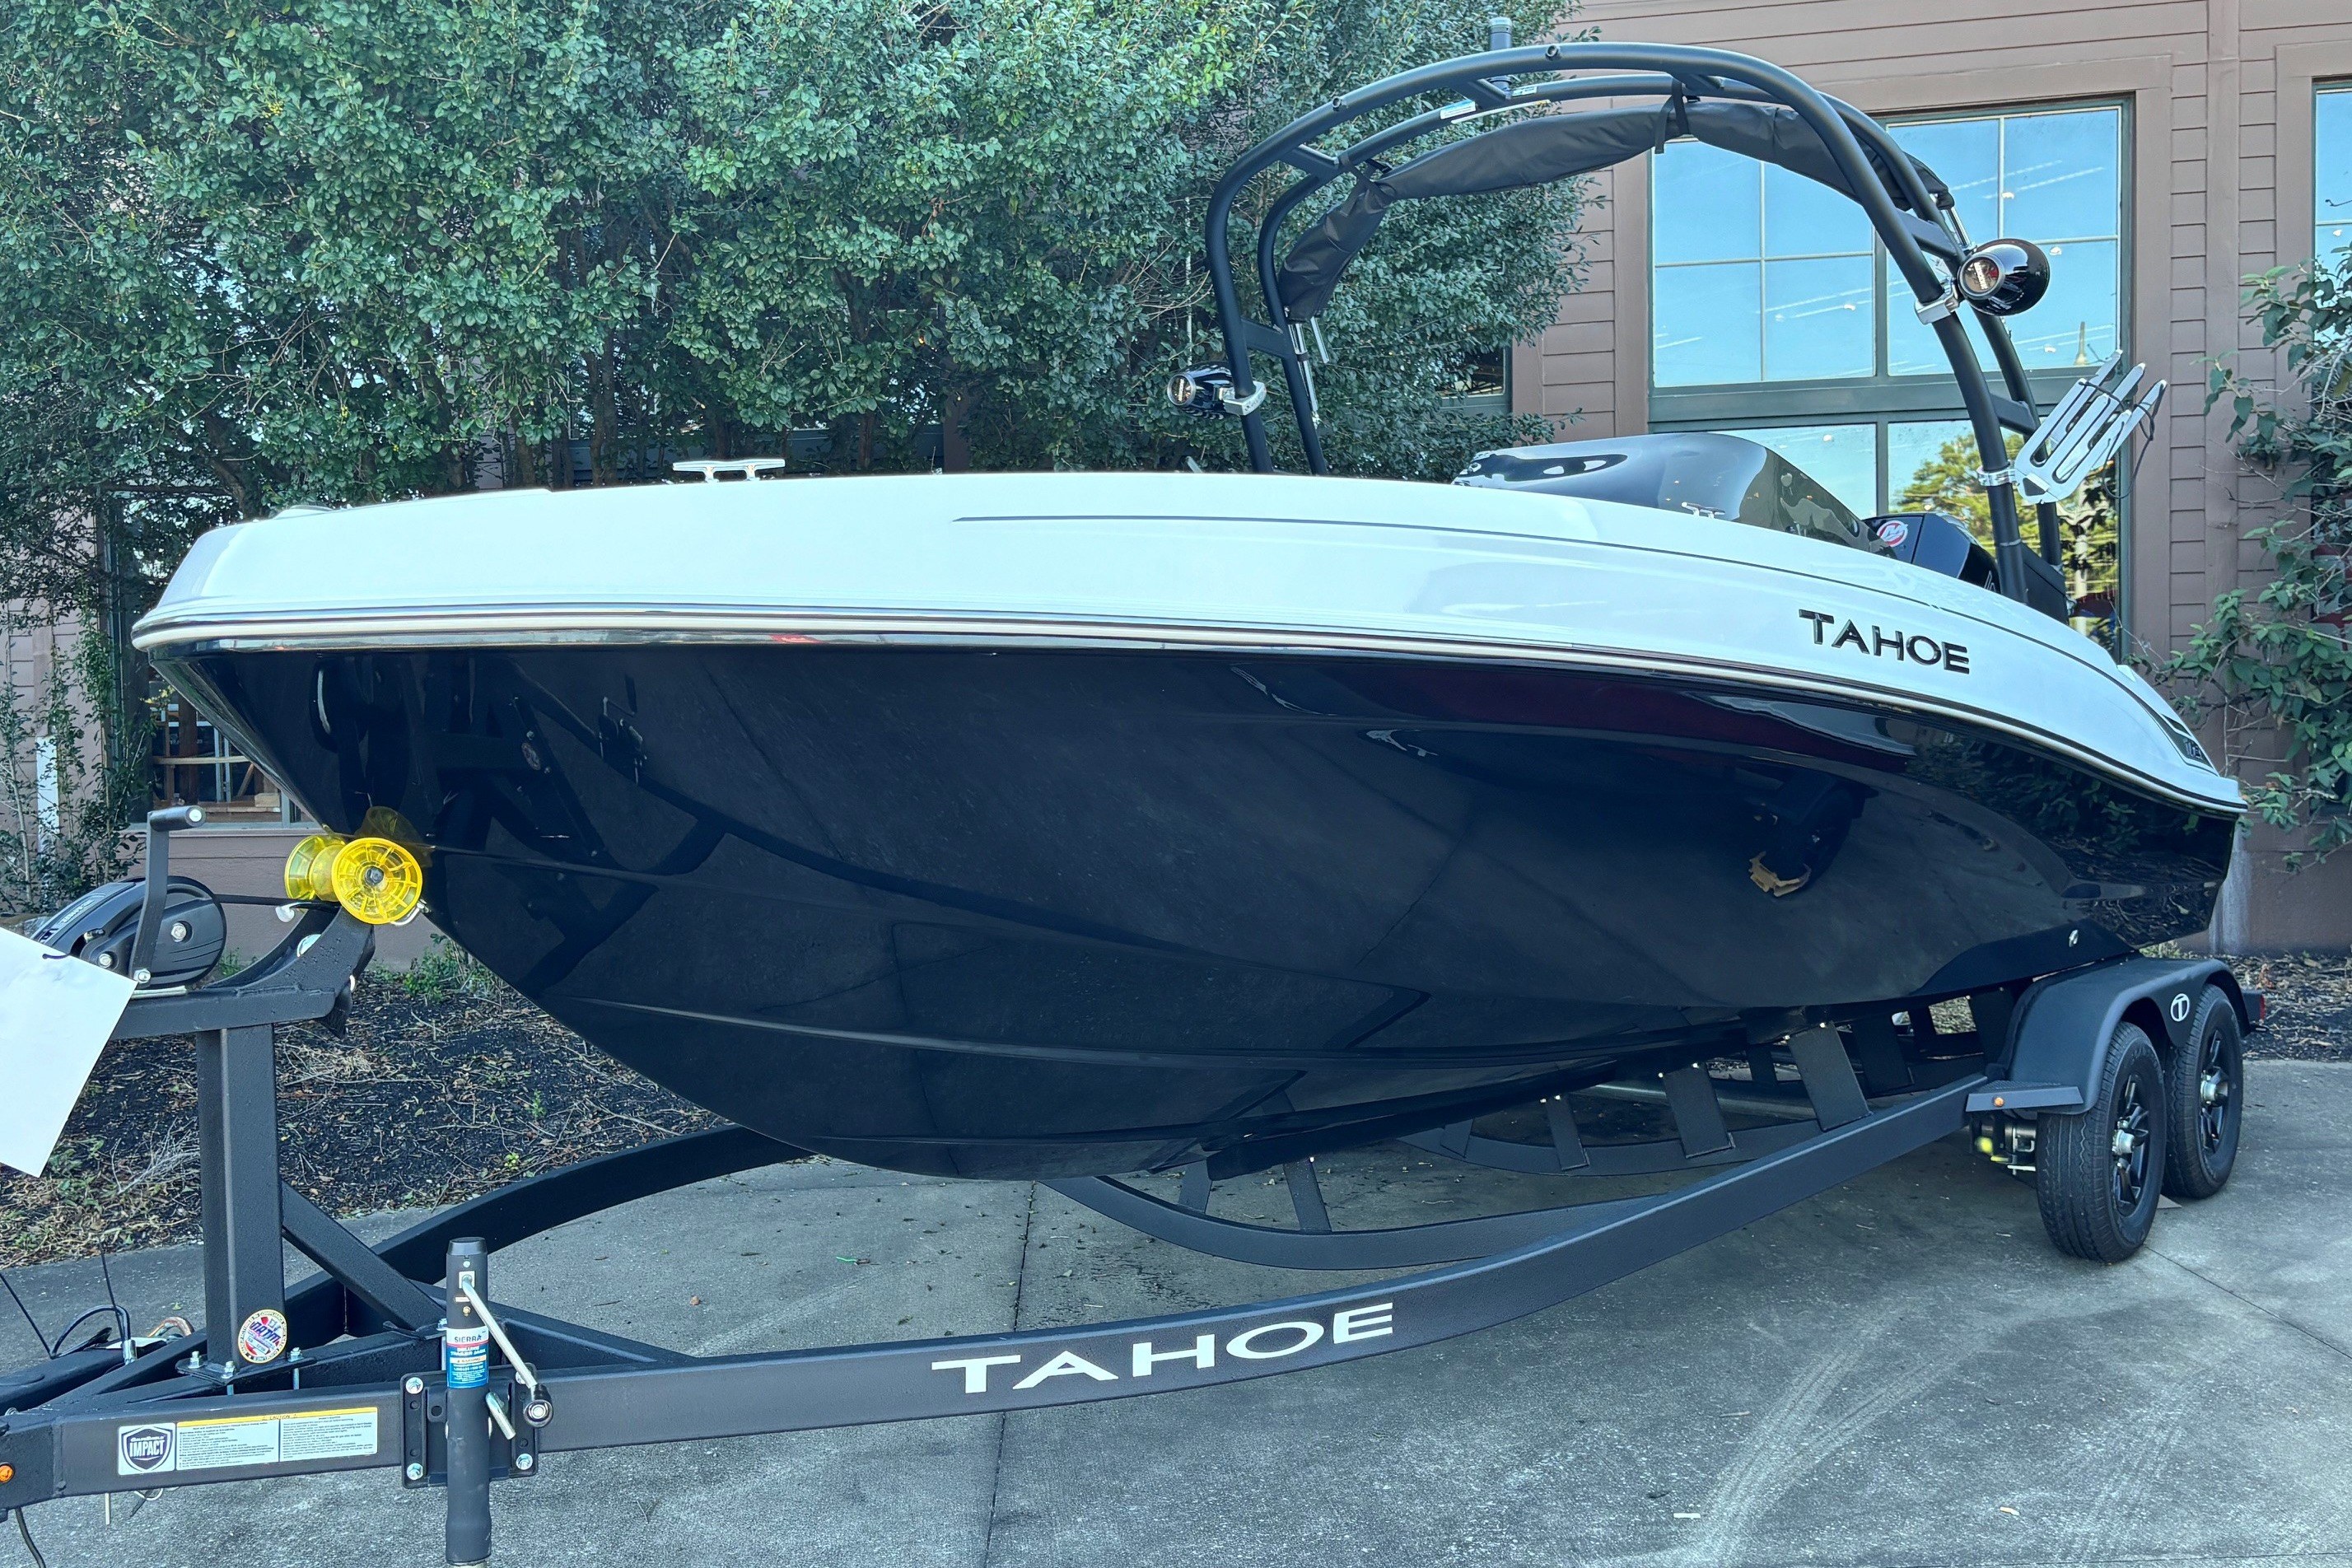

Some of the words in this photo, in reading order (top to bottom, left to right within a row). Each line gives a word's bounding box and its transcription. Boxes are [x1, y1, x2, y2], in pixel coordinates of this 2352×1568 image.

[1799, 609, 1970, 674] TAHOE
[455, 1334, 482, 1343] SIERRA
[931, 1303, 1393, 1393] TAHOE
[130, 1440, 165, 1457] IMPACT
